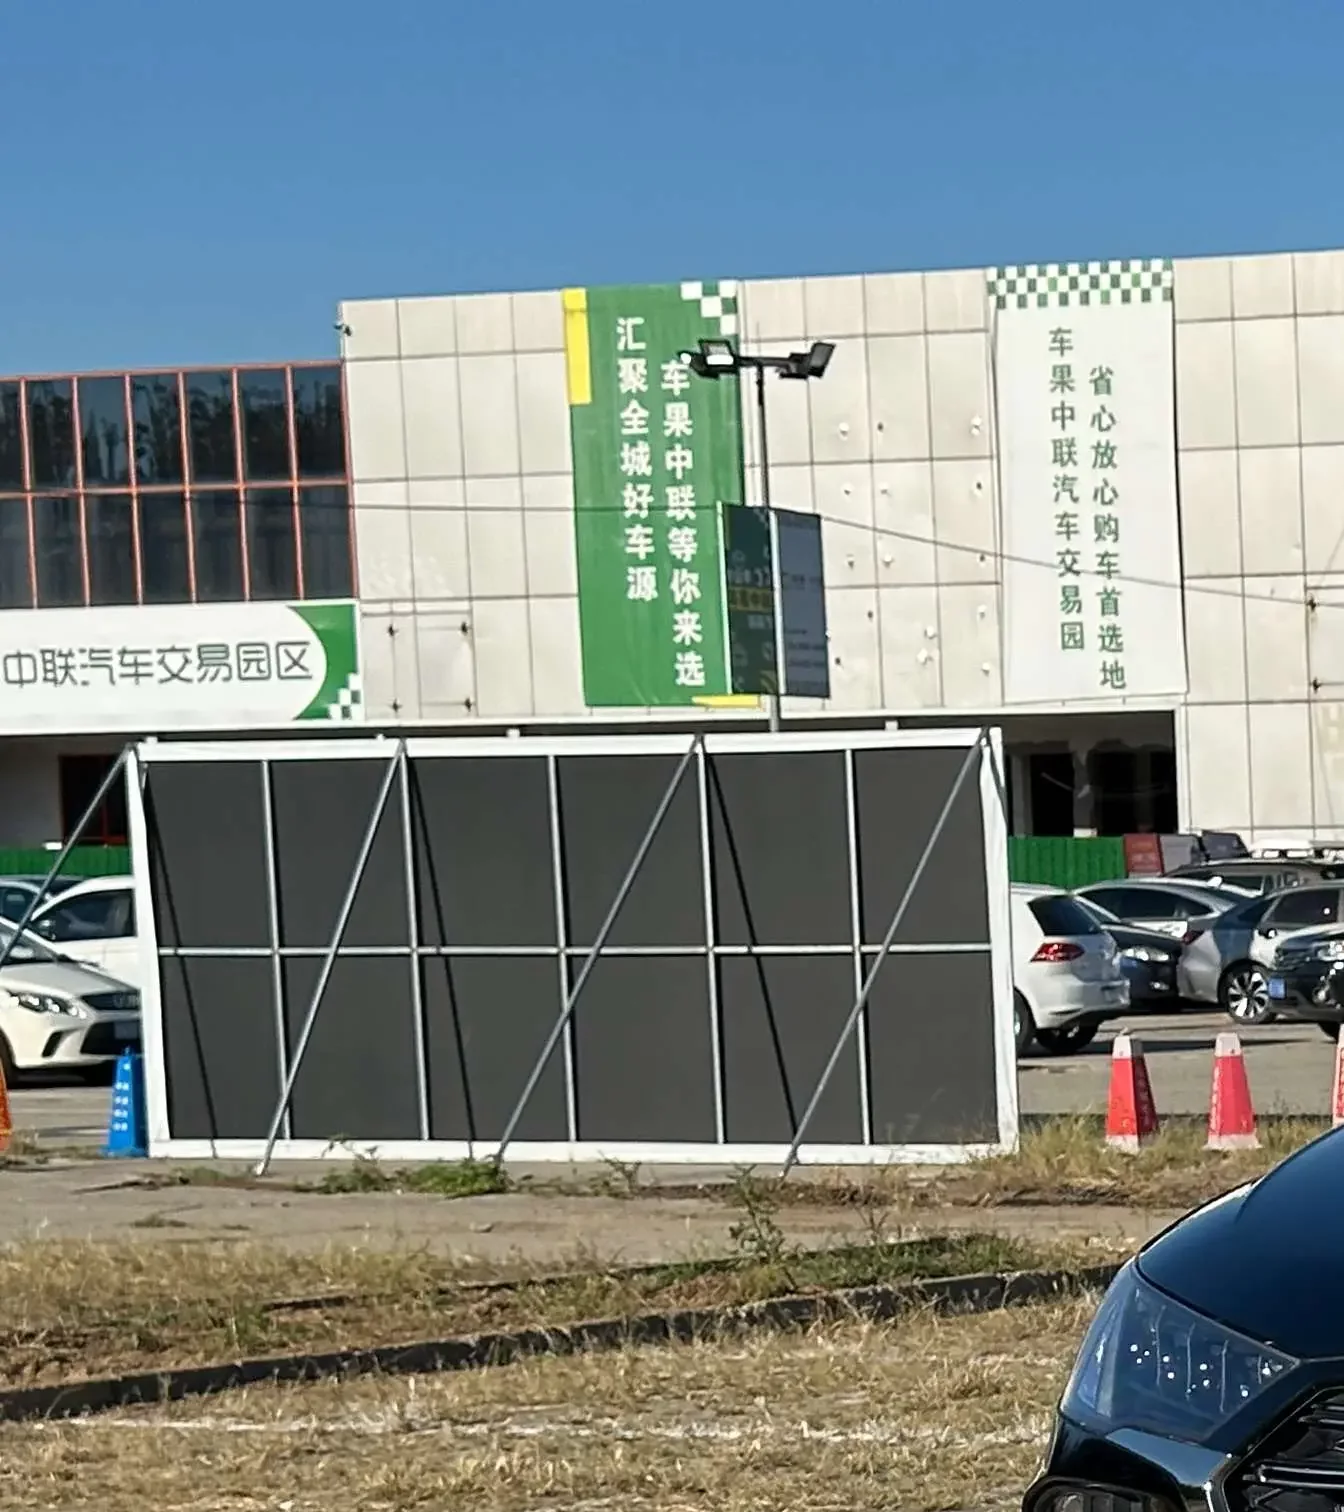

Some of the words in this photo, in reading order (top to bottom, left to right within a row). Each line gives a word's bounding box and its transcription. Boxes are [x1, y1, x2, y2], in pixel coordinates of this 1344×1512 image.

[616, 316, 658, 602] 汇聚全城好车源
[661, 360, 706, 687] 车果中联等你来选
[1048, 327, 1085, 651] 车果中联汽车交易园
[1089, 365, 1126, 690] 省心放心购车首选地
[3, 640, 313, 689] 中联汽车交易园区
